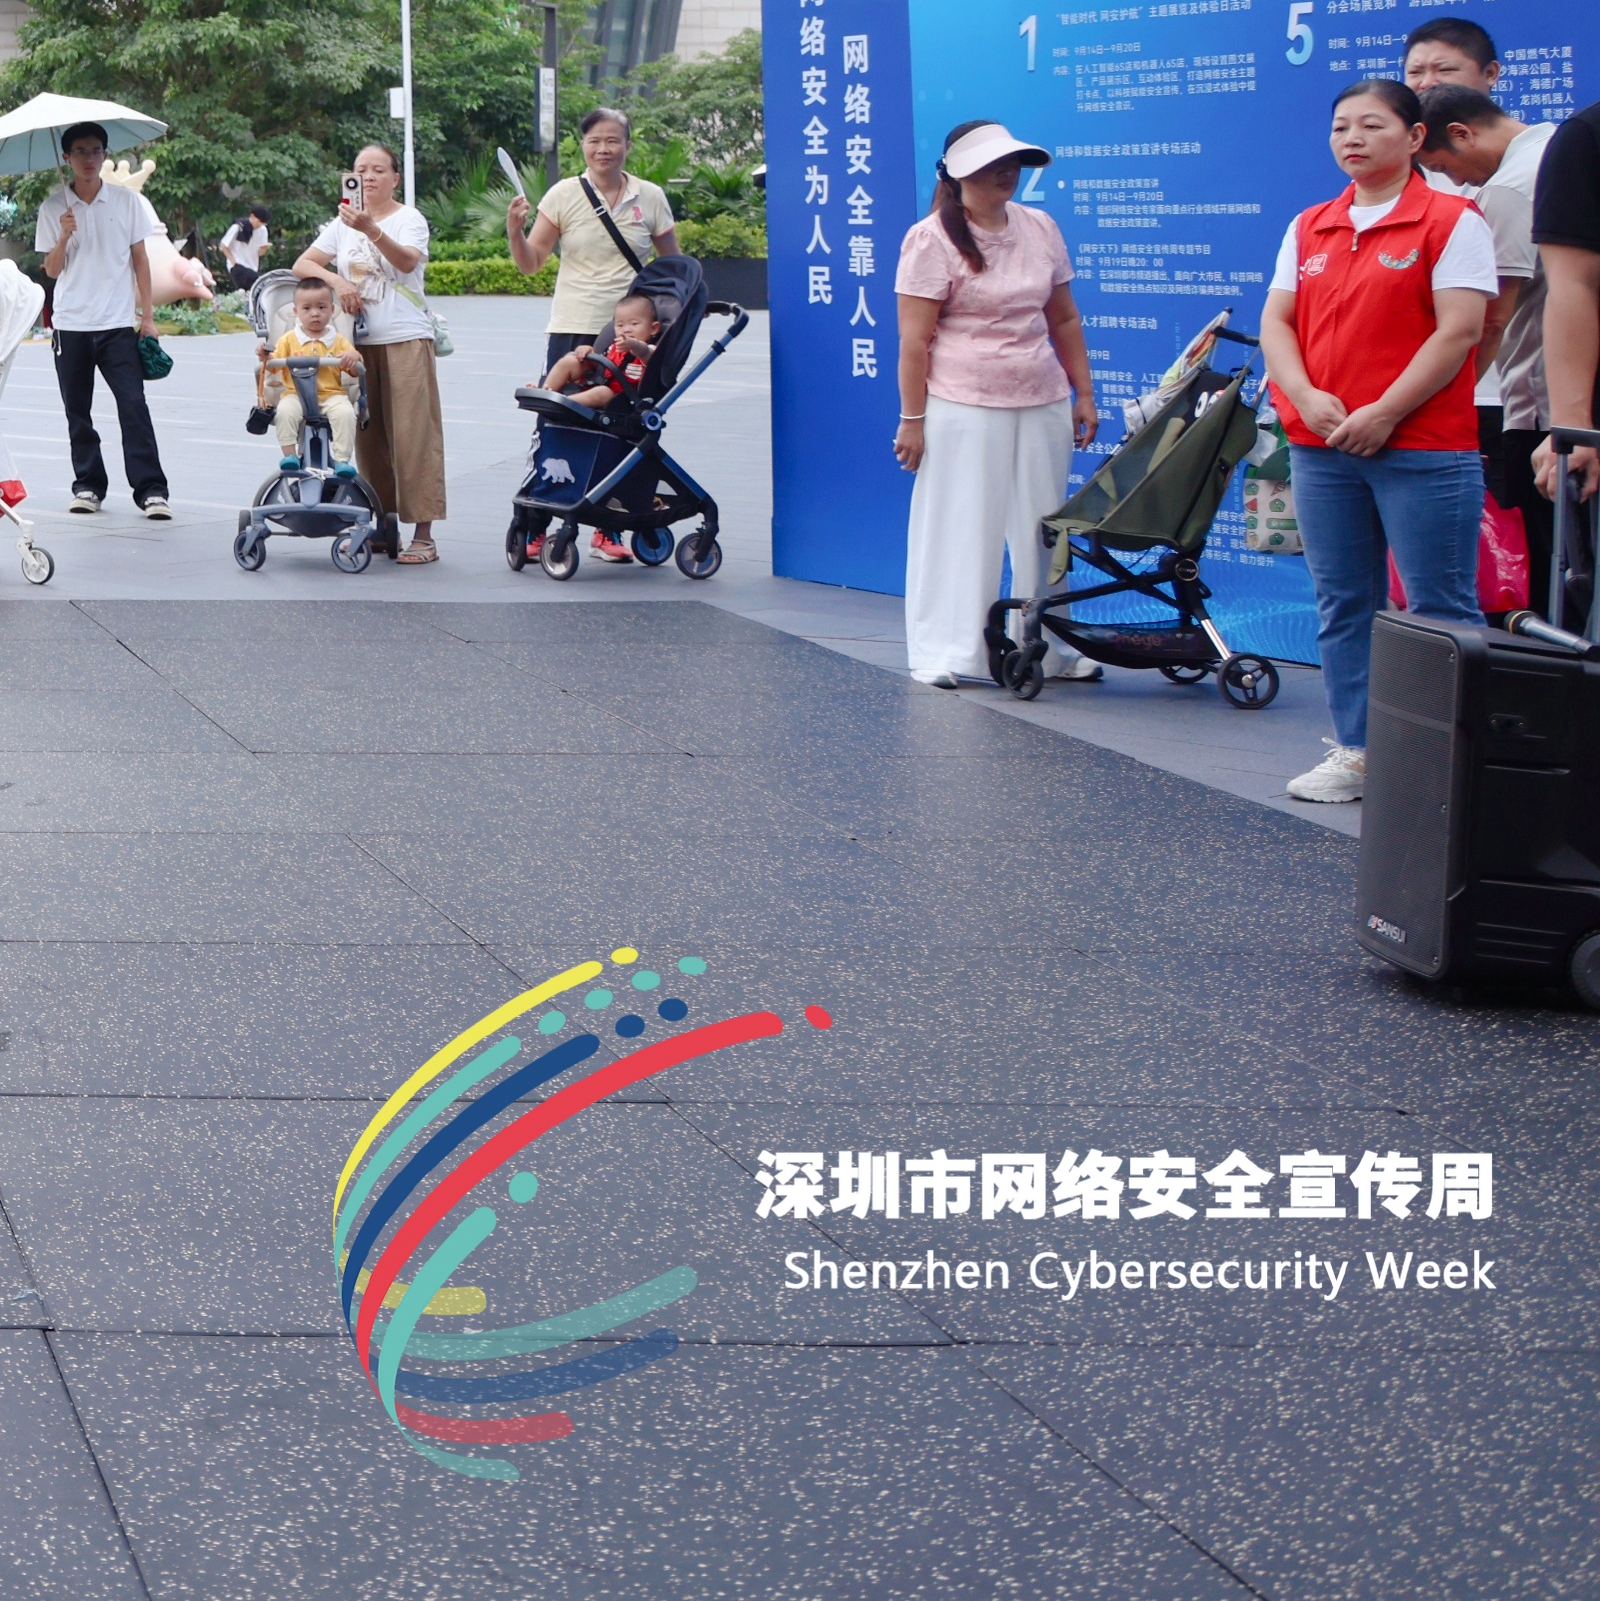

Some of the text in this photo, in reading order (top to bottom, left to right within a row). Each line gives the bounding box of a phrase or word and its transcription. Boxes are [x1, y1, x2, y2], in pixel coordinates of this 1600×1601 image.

[1019, 14, 1038, 73] 1
[1285, 1, 1314, 66] 5
[843, 34, 878, 379] 网络安全靠人民
